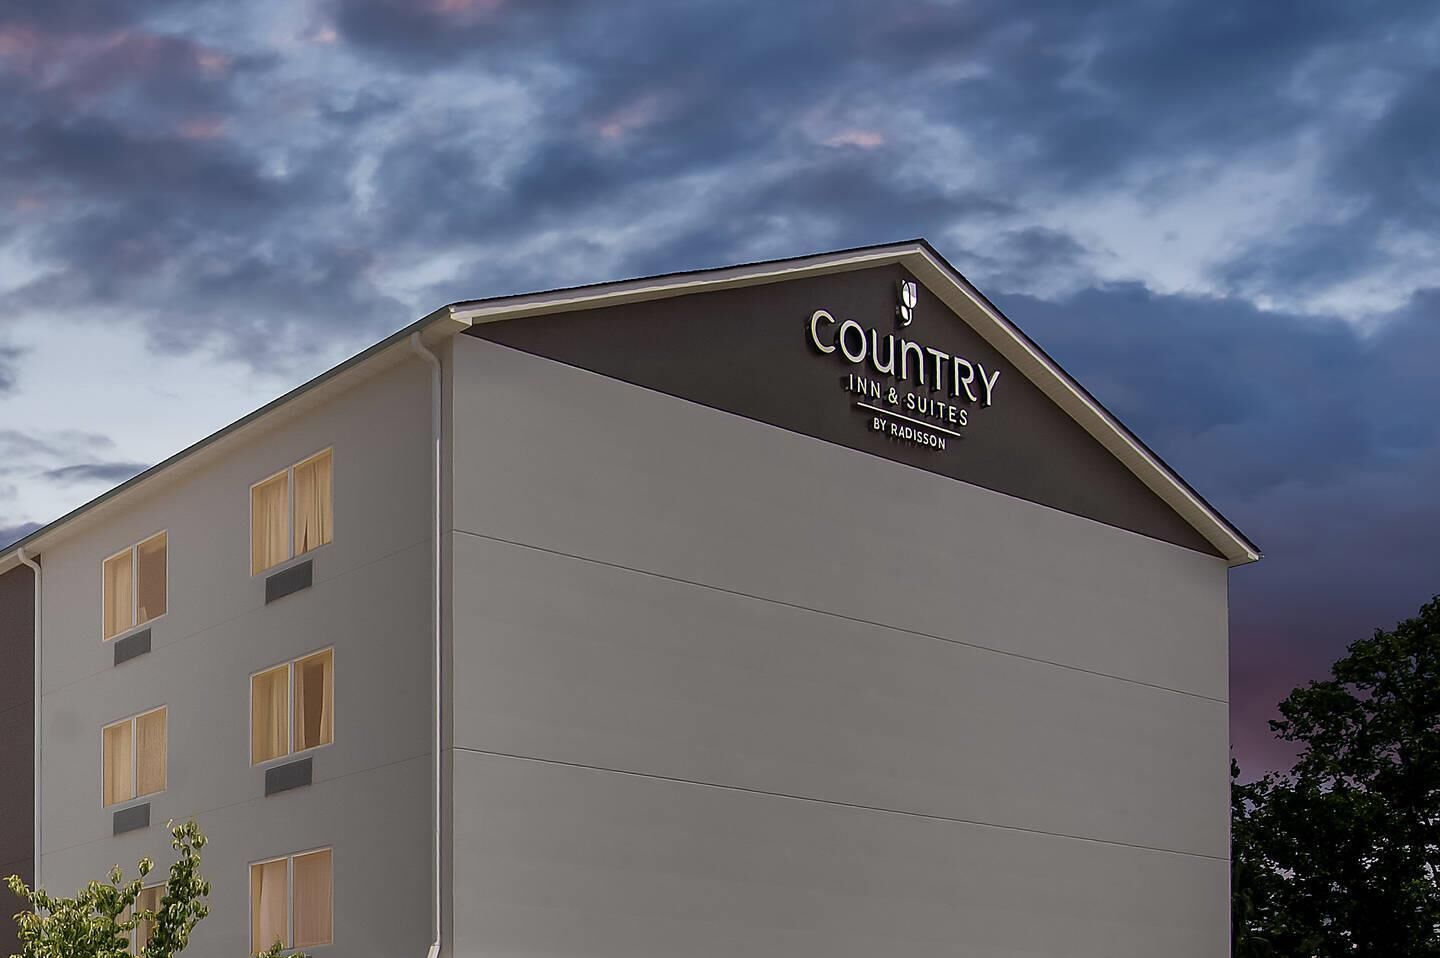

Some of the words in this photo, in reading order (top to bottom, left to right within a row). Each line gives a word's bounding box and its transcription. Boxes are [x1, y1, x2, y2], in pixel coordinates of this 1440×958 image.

[811, 309, 1001, 406] COUNTRY
[849, 373, 882, 399] INN
[887, 387, 899, 405] &
[906, 393, 969, 426] SUITES
[873, 417, 887, 431] BY
[891, 423, 946, 450] RADISSON
